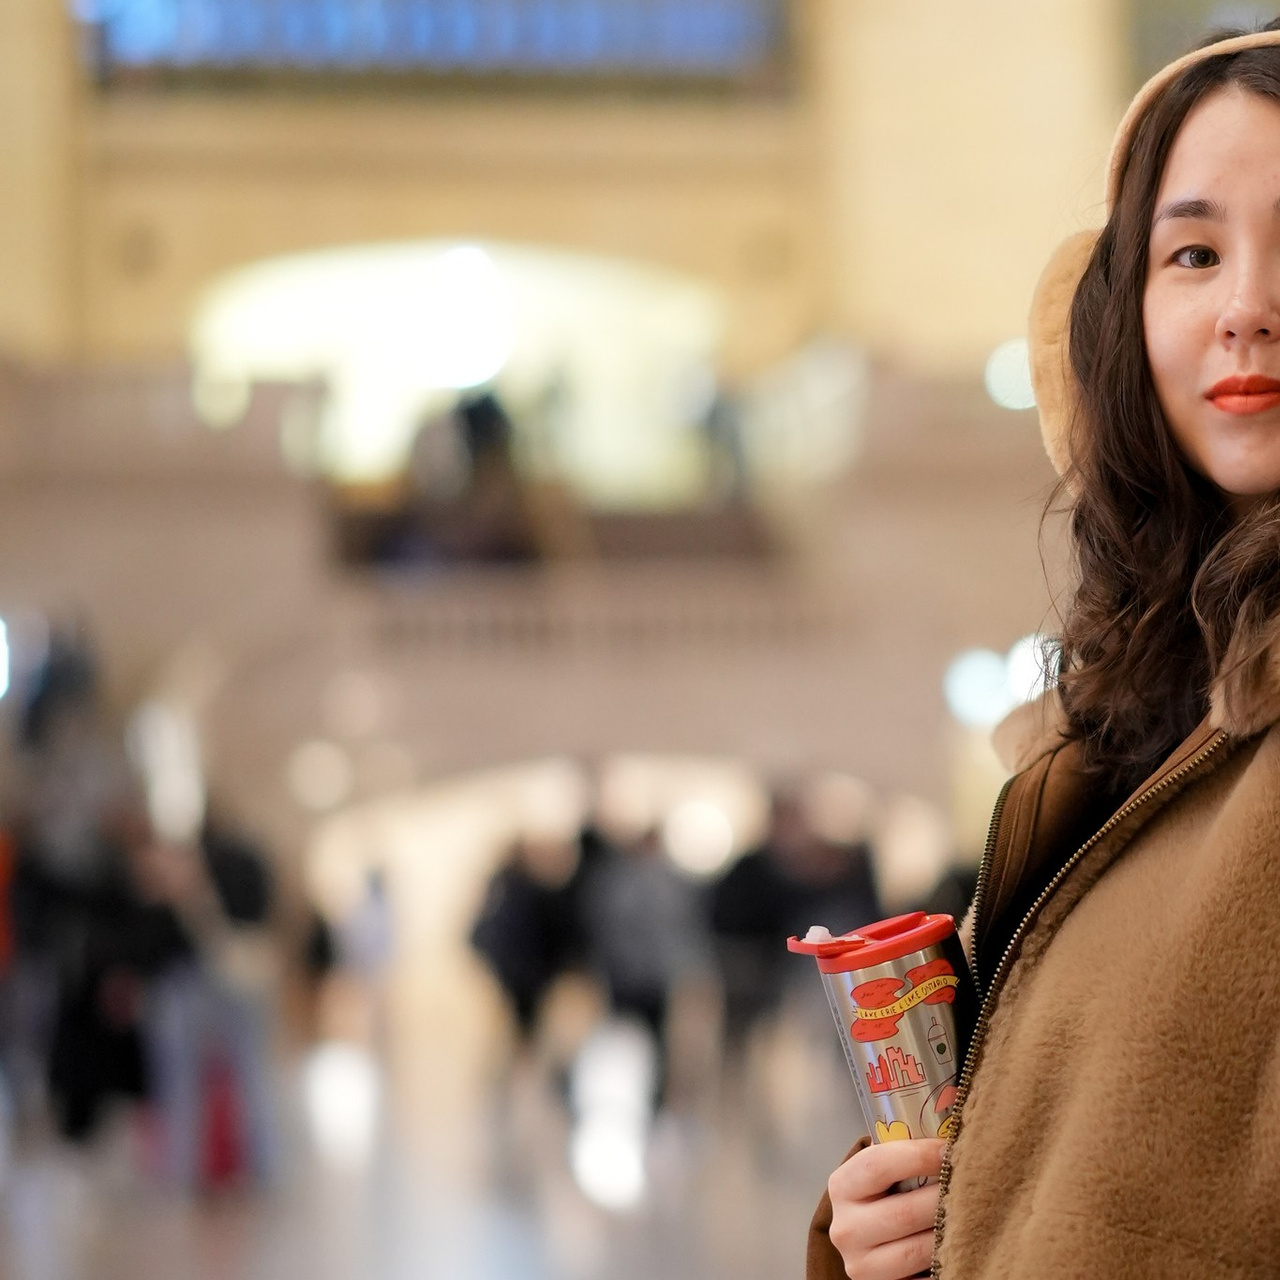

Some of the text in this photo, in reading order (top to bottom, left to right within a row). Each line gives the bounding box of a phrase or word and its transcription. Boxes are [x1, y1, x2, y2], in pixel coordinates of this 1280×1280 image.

[860, 1011, 877, 1019] LAKE
[880, 1006, 897, 1017] ERIE
[904, 990, 921, 1007] LAKE
[921, 977, 948, 995] ONTARIO
